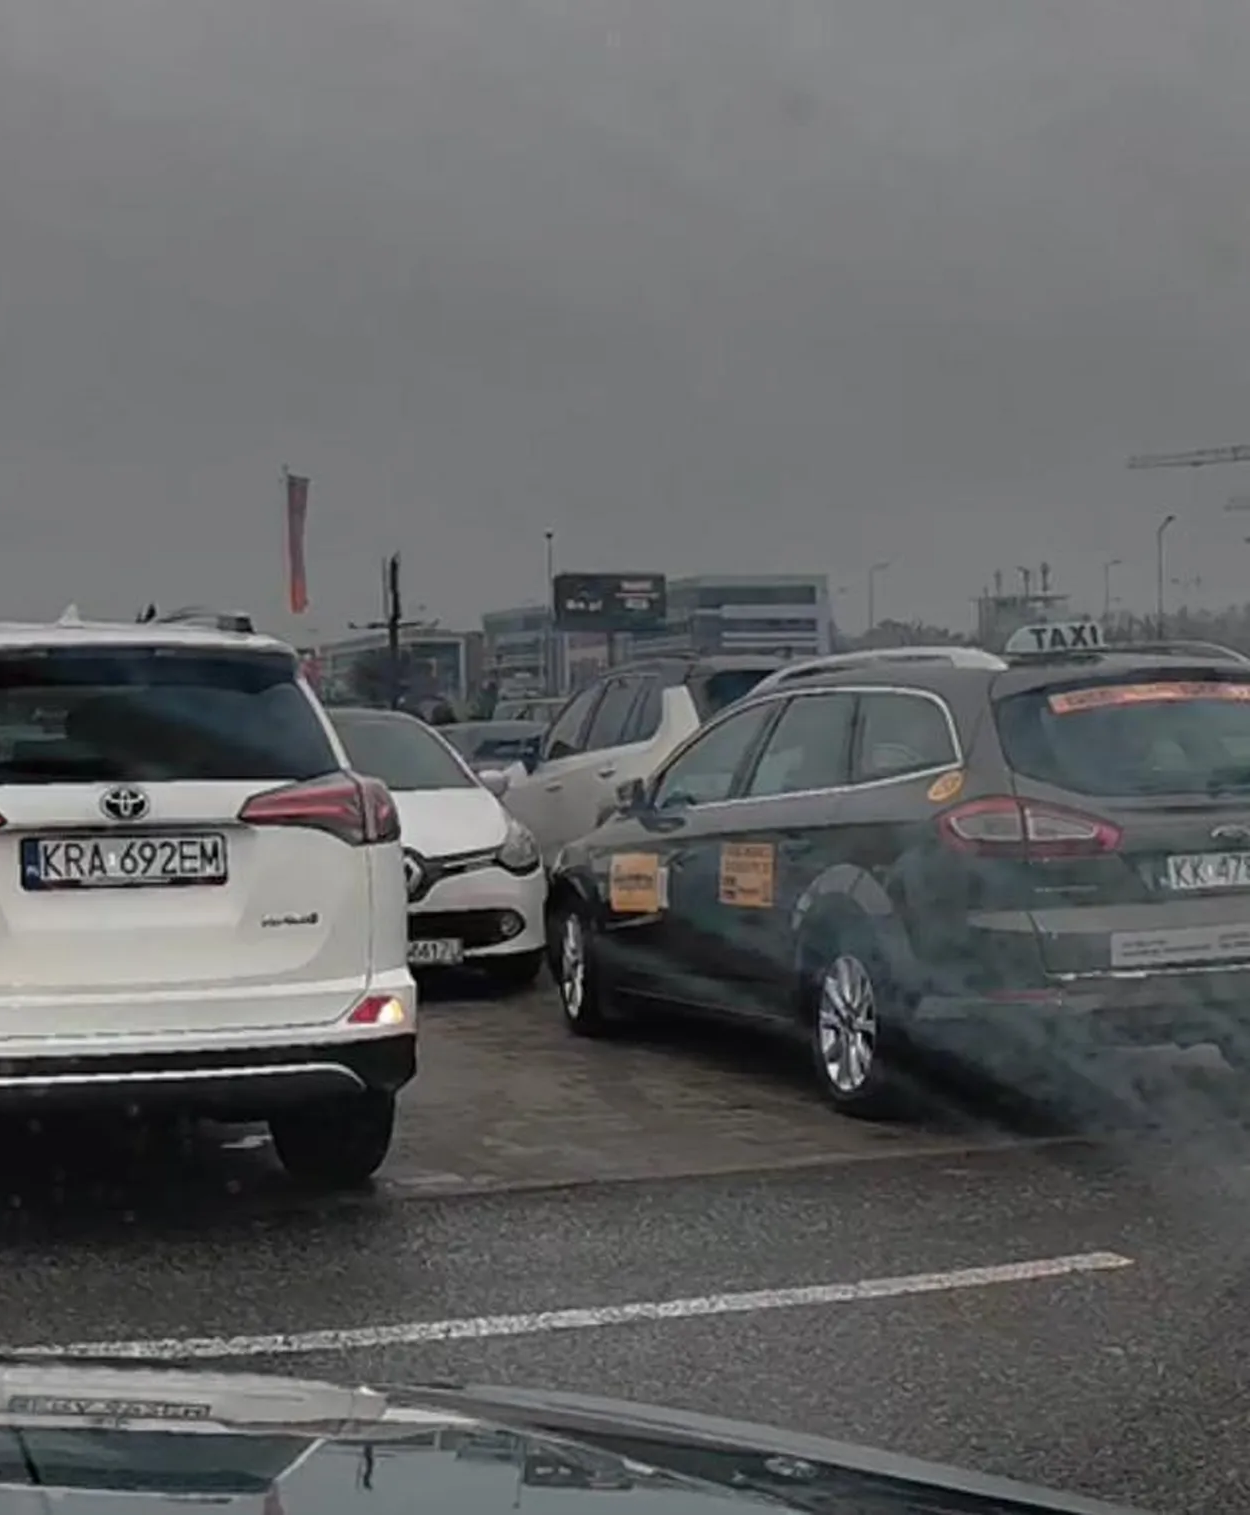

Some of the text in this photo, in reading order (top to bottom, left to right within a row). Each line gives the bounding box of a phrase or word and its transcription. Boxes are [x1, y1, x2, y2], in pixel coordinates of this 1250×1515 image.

[1030, 625, 1098, 649] TAXI
[43, 840, 221, 878] KRA 692EM
[1172, 856, 1207, 887] KK
